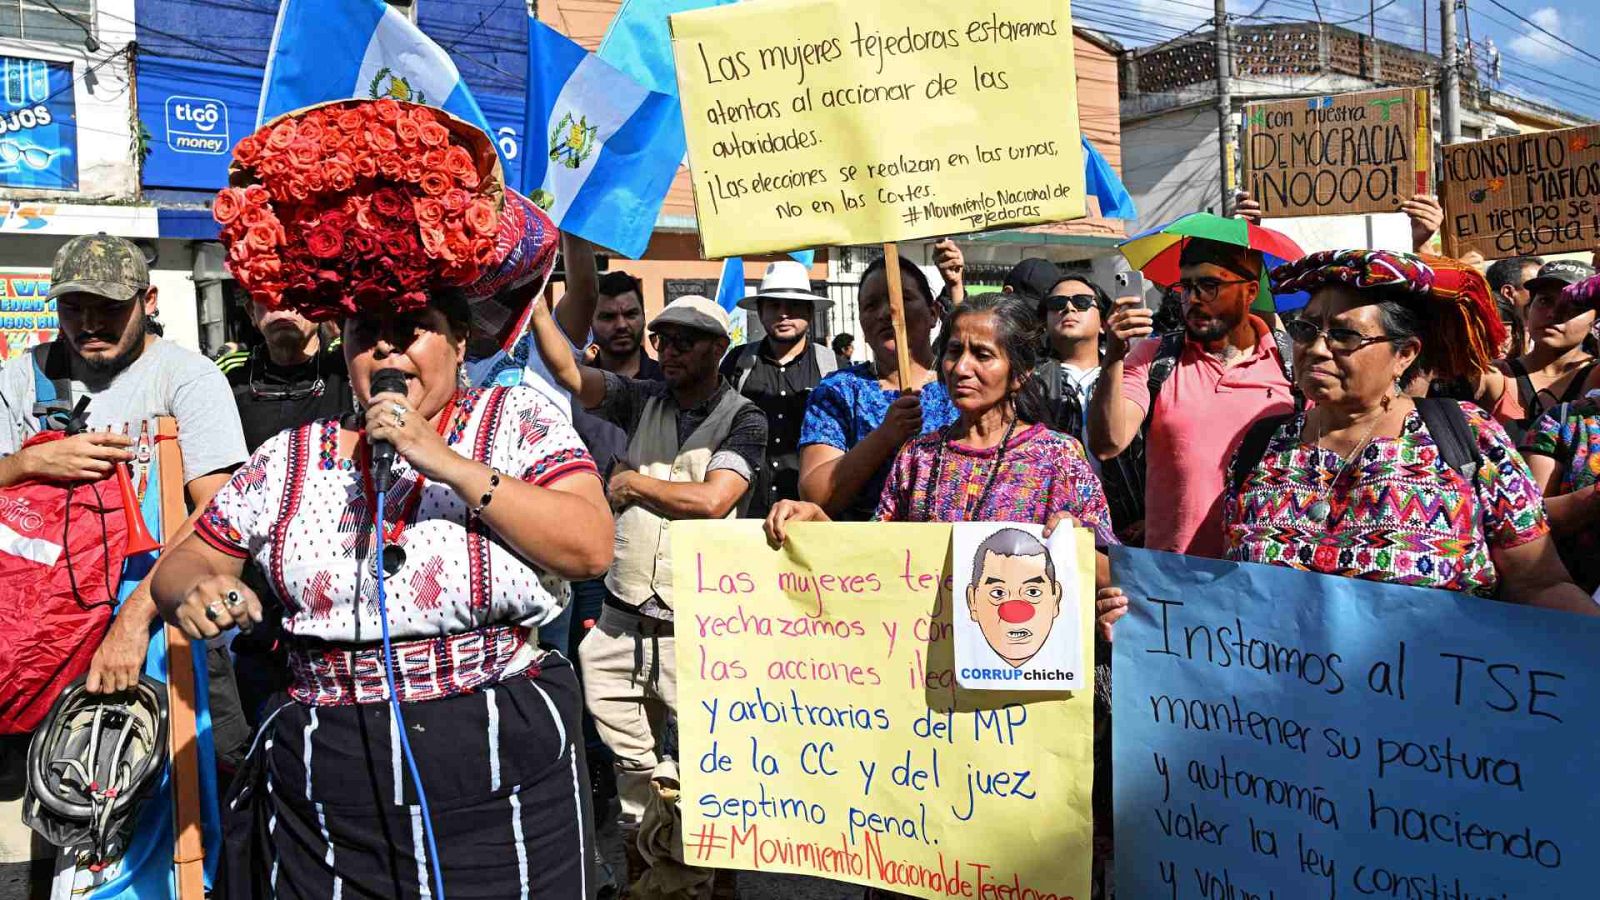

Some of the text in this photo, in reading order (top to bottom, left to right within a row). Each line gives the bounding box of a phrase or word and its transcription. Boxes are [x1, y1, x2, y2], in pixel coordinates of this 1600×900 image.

[698, 12, 1057, 85] Las mujeres tejedoras estaremos
[707, 65, 1009, 125] atentas al accionar de las
[1305, 105, 1366, 125] nuestra
[176, 137, 223, 152] money
[712, 128, 823, 158] autoridades.
[752, 168, 827, 193] elecciones
[840, 164, 858, 182] se
[868, 154, 940, 179] realizan
[947, 153, 969, 167] en
[976, 145, 1002, 163] las
[1009, 141, 1059, 160] urnas,
[1251, 124, 1408, 171] DEMOCRACIA
[1445, 136, 1565, 182] ¡CONSUELO
[812, 199, 834, 214] en
[841, 190, 866, 211] las
[997, 184, 1051, 206] Nacional
[1053, 184, 1071, 198] de
[1252, 165, 1399, 212] ¡NOOOO!
[960, 204, 1041, 227] Tejedoras
[1456, 200, 1592, 237] El tiempo se
[696, 552, 755, 595] Las
[778, 566, 882, 618] mujeres
[696, 607, 865, 640] rechazamos
[883, 621, 897, 659] y
[698, 645, 748, 682] las
[767, 657, 882, 686] acciones
[961, 667, 1075, 683] CORRUPchiche
[1146, 597, 1567, 723] Instamos al TSE
[729, 687, 890, 731] arbitrarias
[913, 705, 953, 745] del
[974, 703, 1028, 746] MP
[1150, 695, 1525, 791] mantener su postura
[699, 737, 1037, 822] de la CC y del juez
[699, 783, 940, 846] septimo penal.
[1153, 752, 1170, 801] y
[1369, 788, 1562, 868] haciendo
[1249, 818, 1279, 859] la
[1299, 833, 1336, 900] ley
